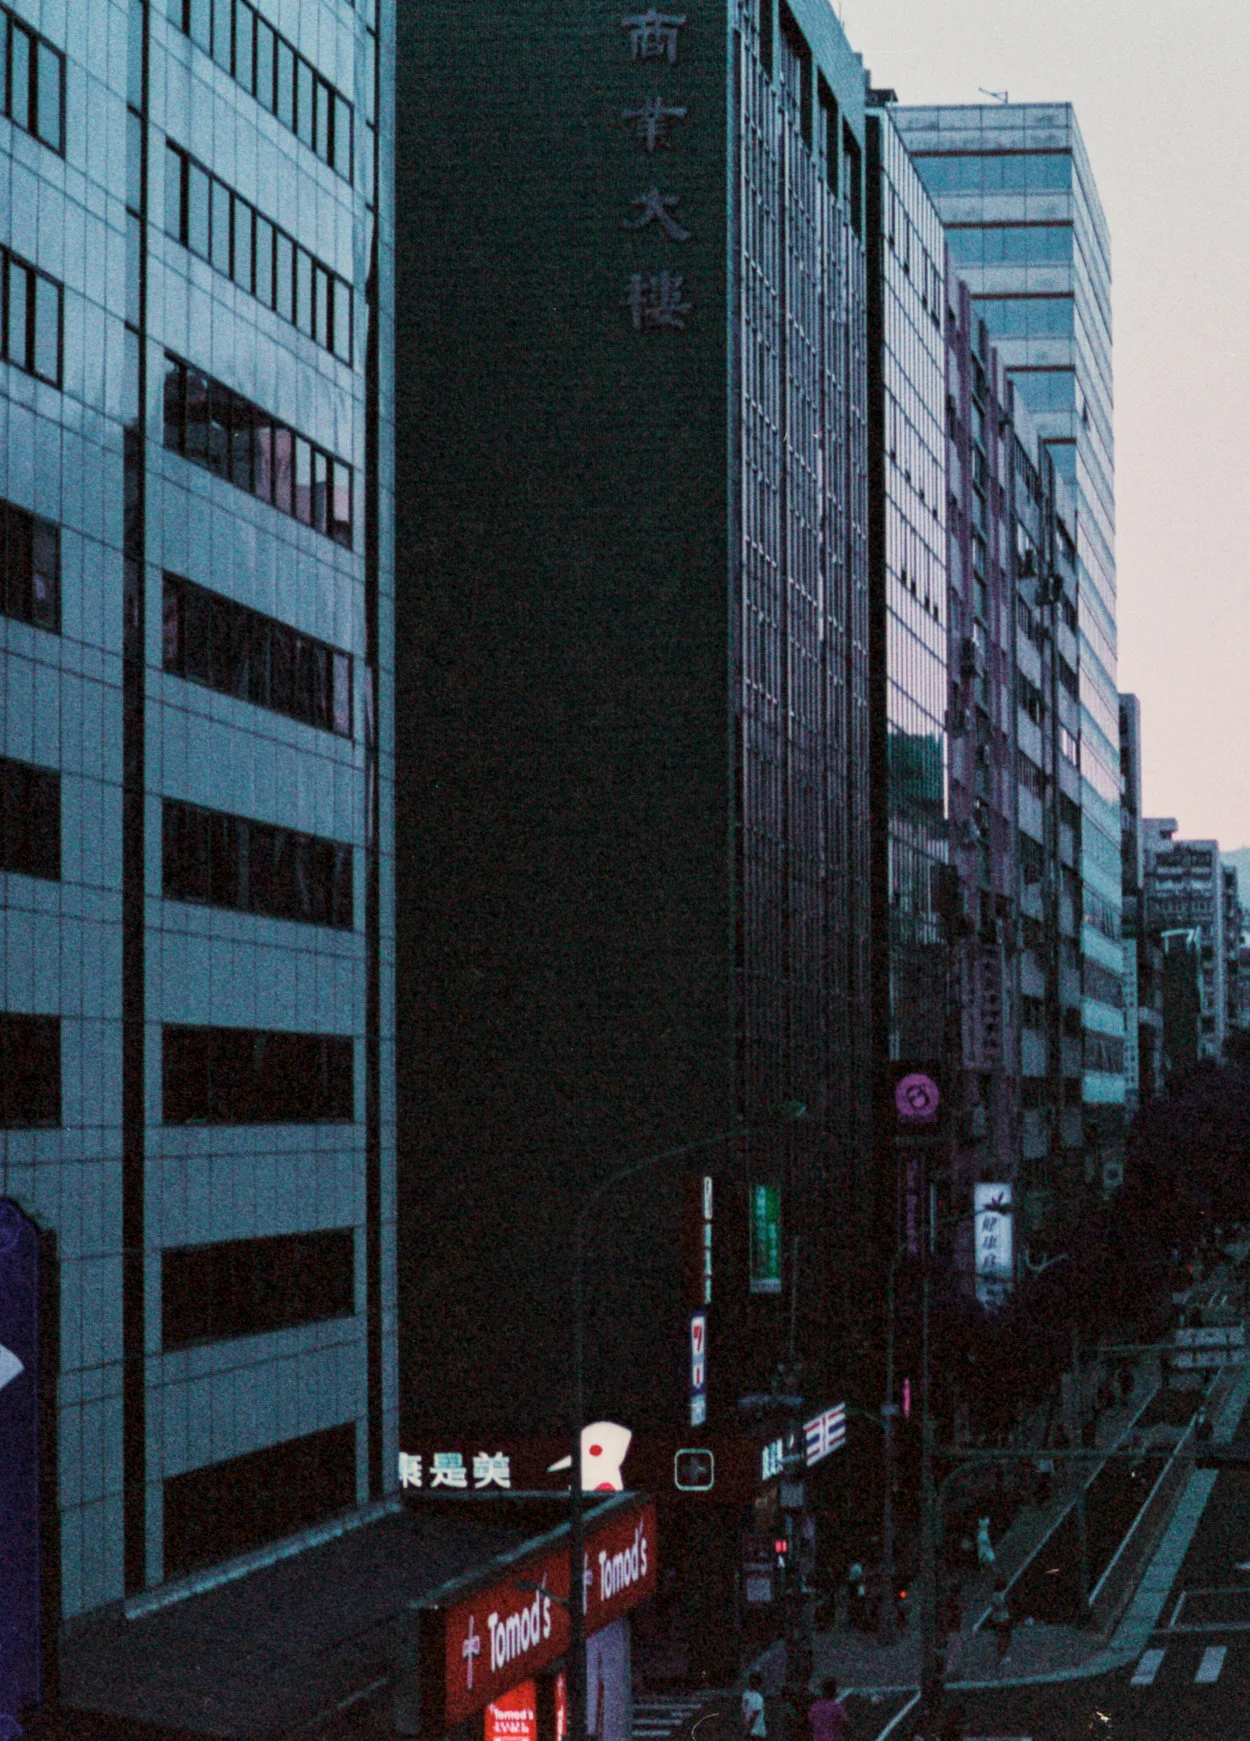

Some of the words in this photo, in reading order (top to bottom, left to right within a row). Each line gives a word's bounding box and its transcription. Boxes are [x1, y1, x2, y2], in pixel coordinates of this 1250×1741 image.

[620, 8, 693, 331] 商業大樓
[598, 1518, 647, 1602] Tomod's
[487, 1573, 551, 1672] Tomod's
